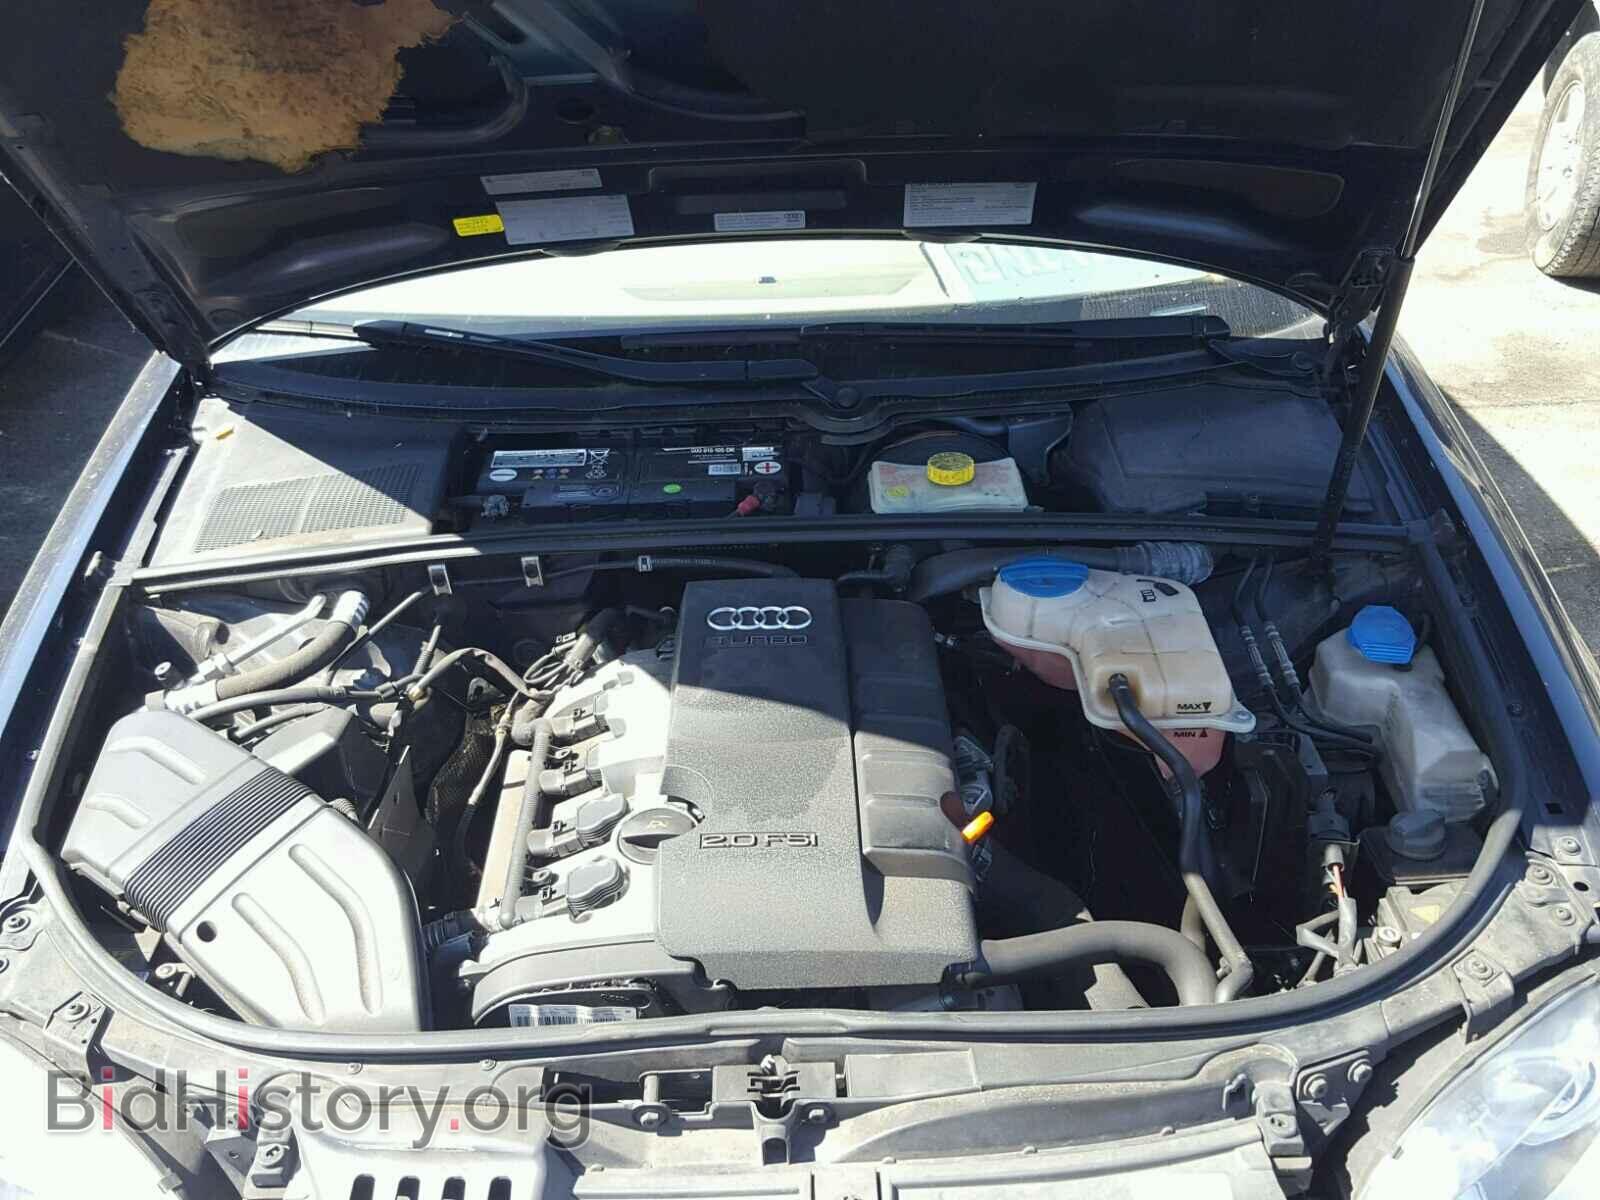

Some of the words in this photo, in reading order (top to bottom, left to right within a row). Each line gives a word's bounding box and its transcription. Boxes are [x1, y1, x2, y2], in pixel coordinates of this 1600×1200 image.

[707, 634, 809, 647] TURBO
[700, 832, 758, 849] 2.0
[764, 832, 819, 848] FSI
